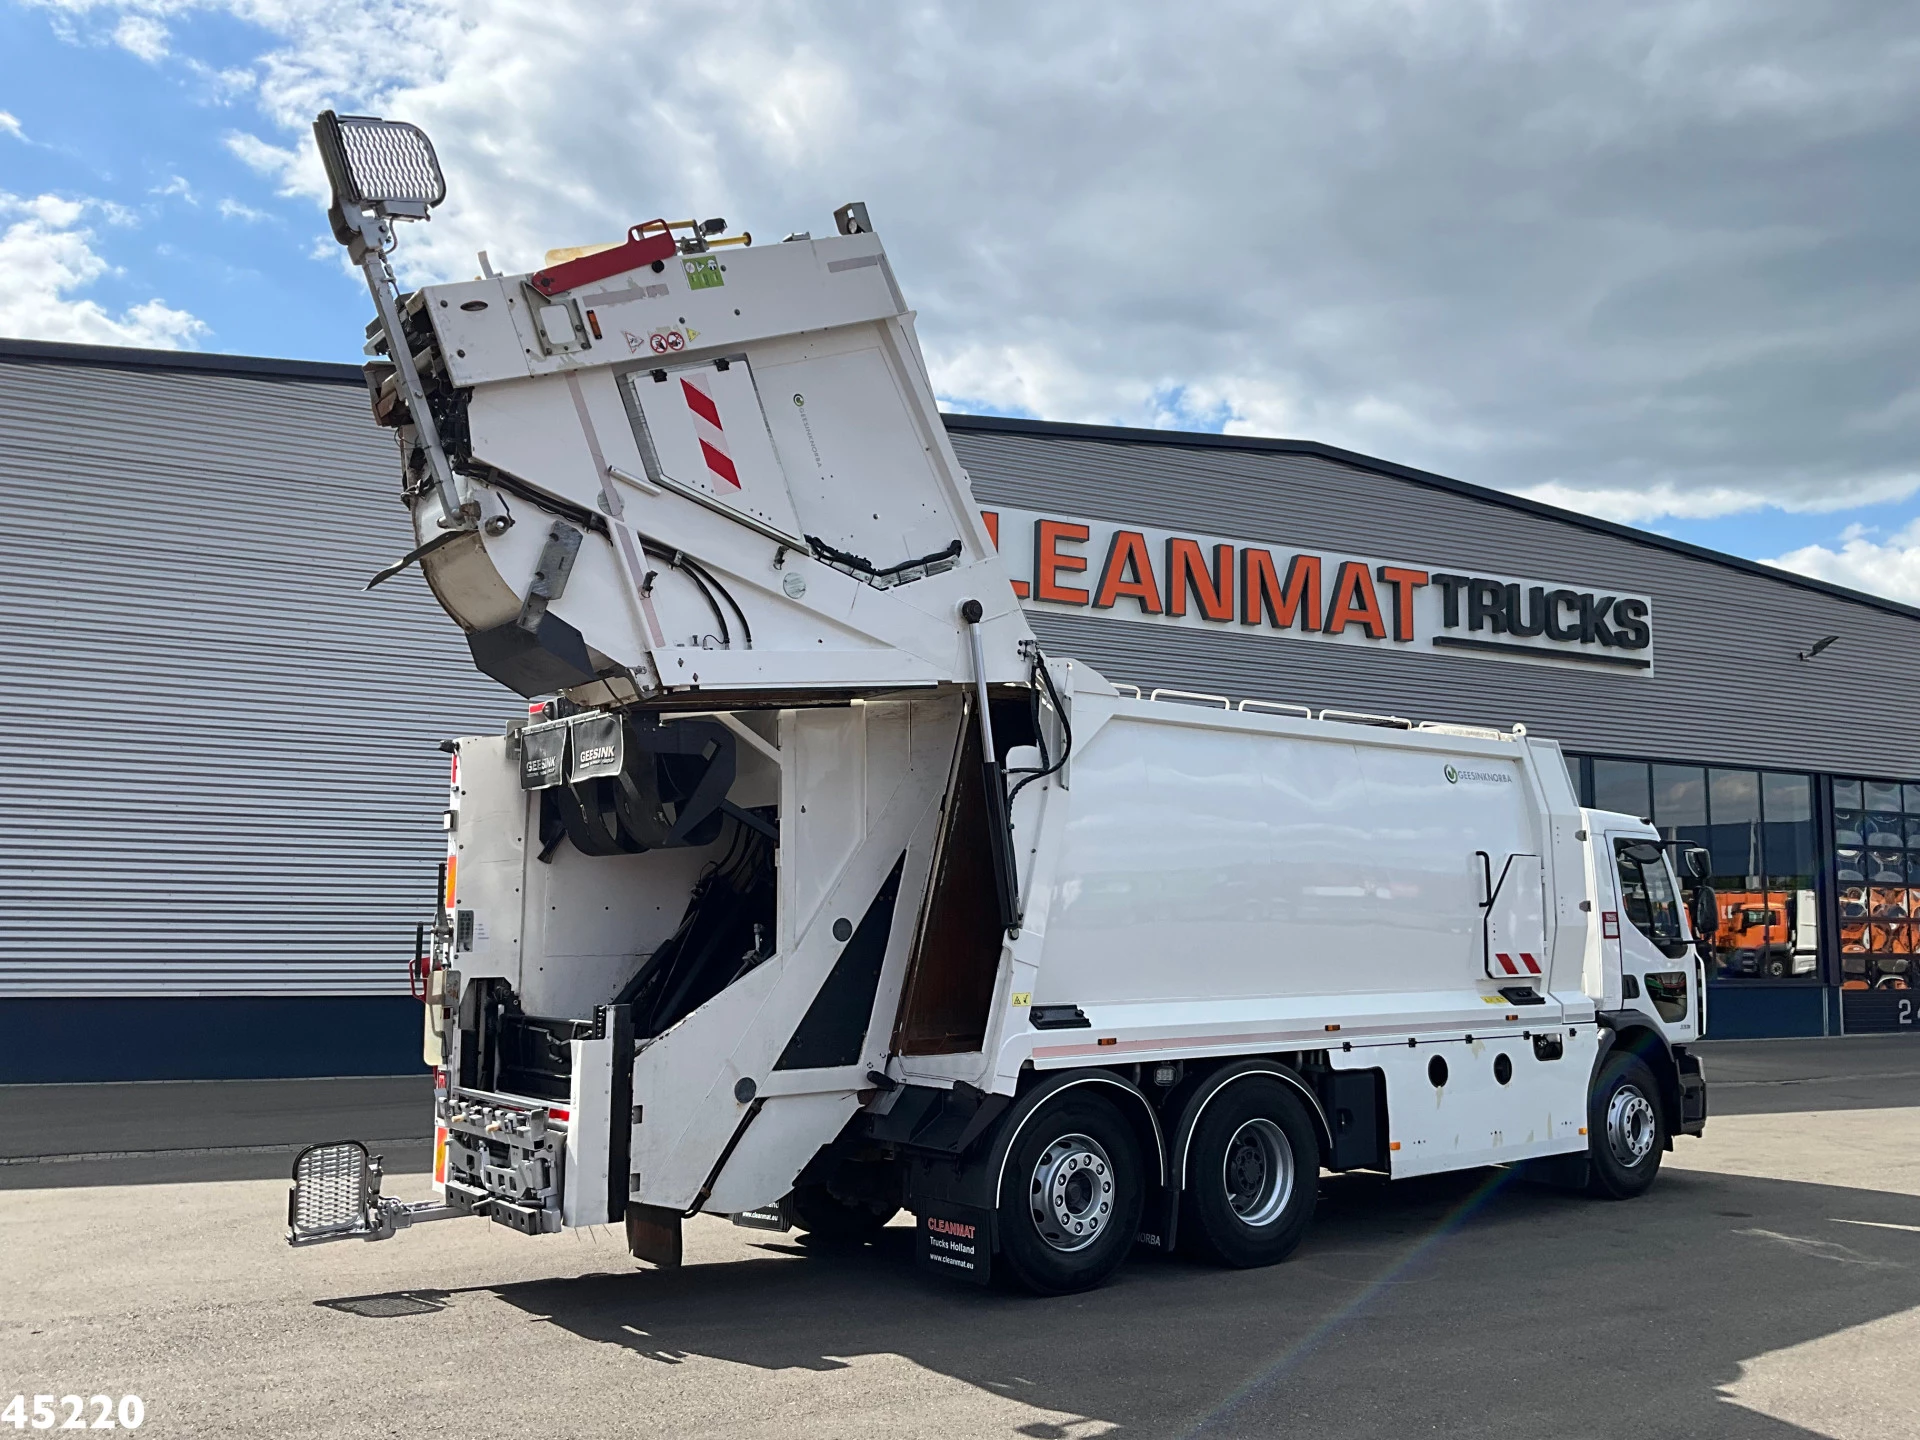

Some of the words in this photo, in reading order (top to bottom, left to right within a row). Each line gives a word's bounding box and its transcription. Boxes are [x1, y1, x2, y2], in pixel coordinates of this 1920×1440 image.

[980, 510, 1428, 642] EANMAT
[1431, 572, 1651, 650] TRUCKS
[526, 755, 557, 772] GEESINK
[580, 745, 615, 763] GEESINK
[1457, 770, 1513, 783] GEESINKNORBA
[1898, 998, 1920, 1024] 2
[927, 1217, 976, 1239] CLEANMAT
[929, 1235, 949, 1249] Trucks
[949, 1240, 975, 1255] Holland
[929, 1253, 974, 1270] www.cleanmat.eu
